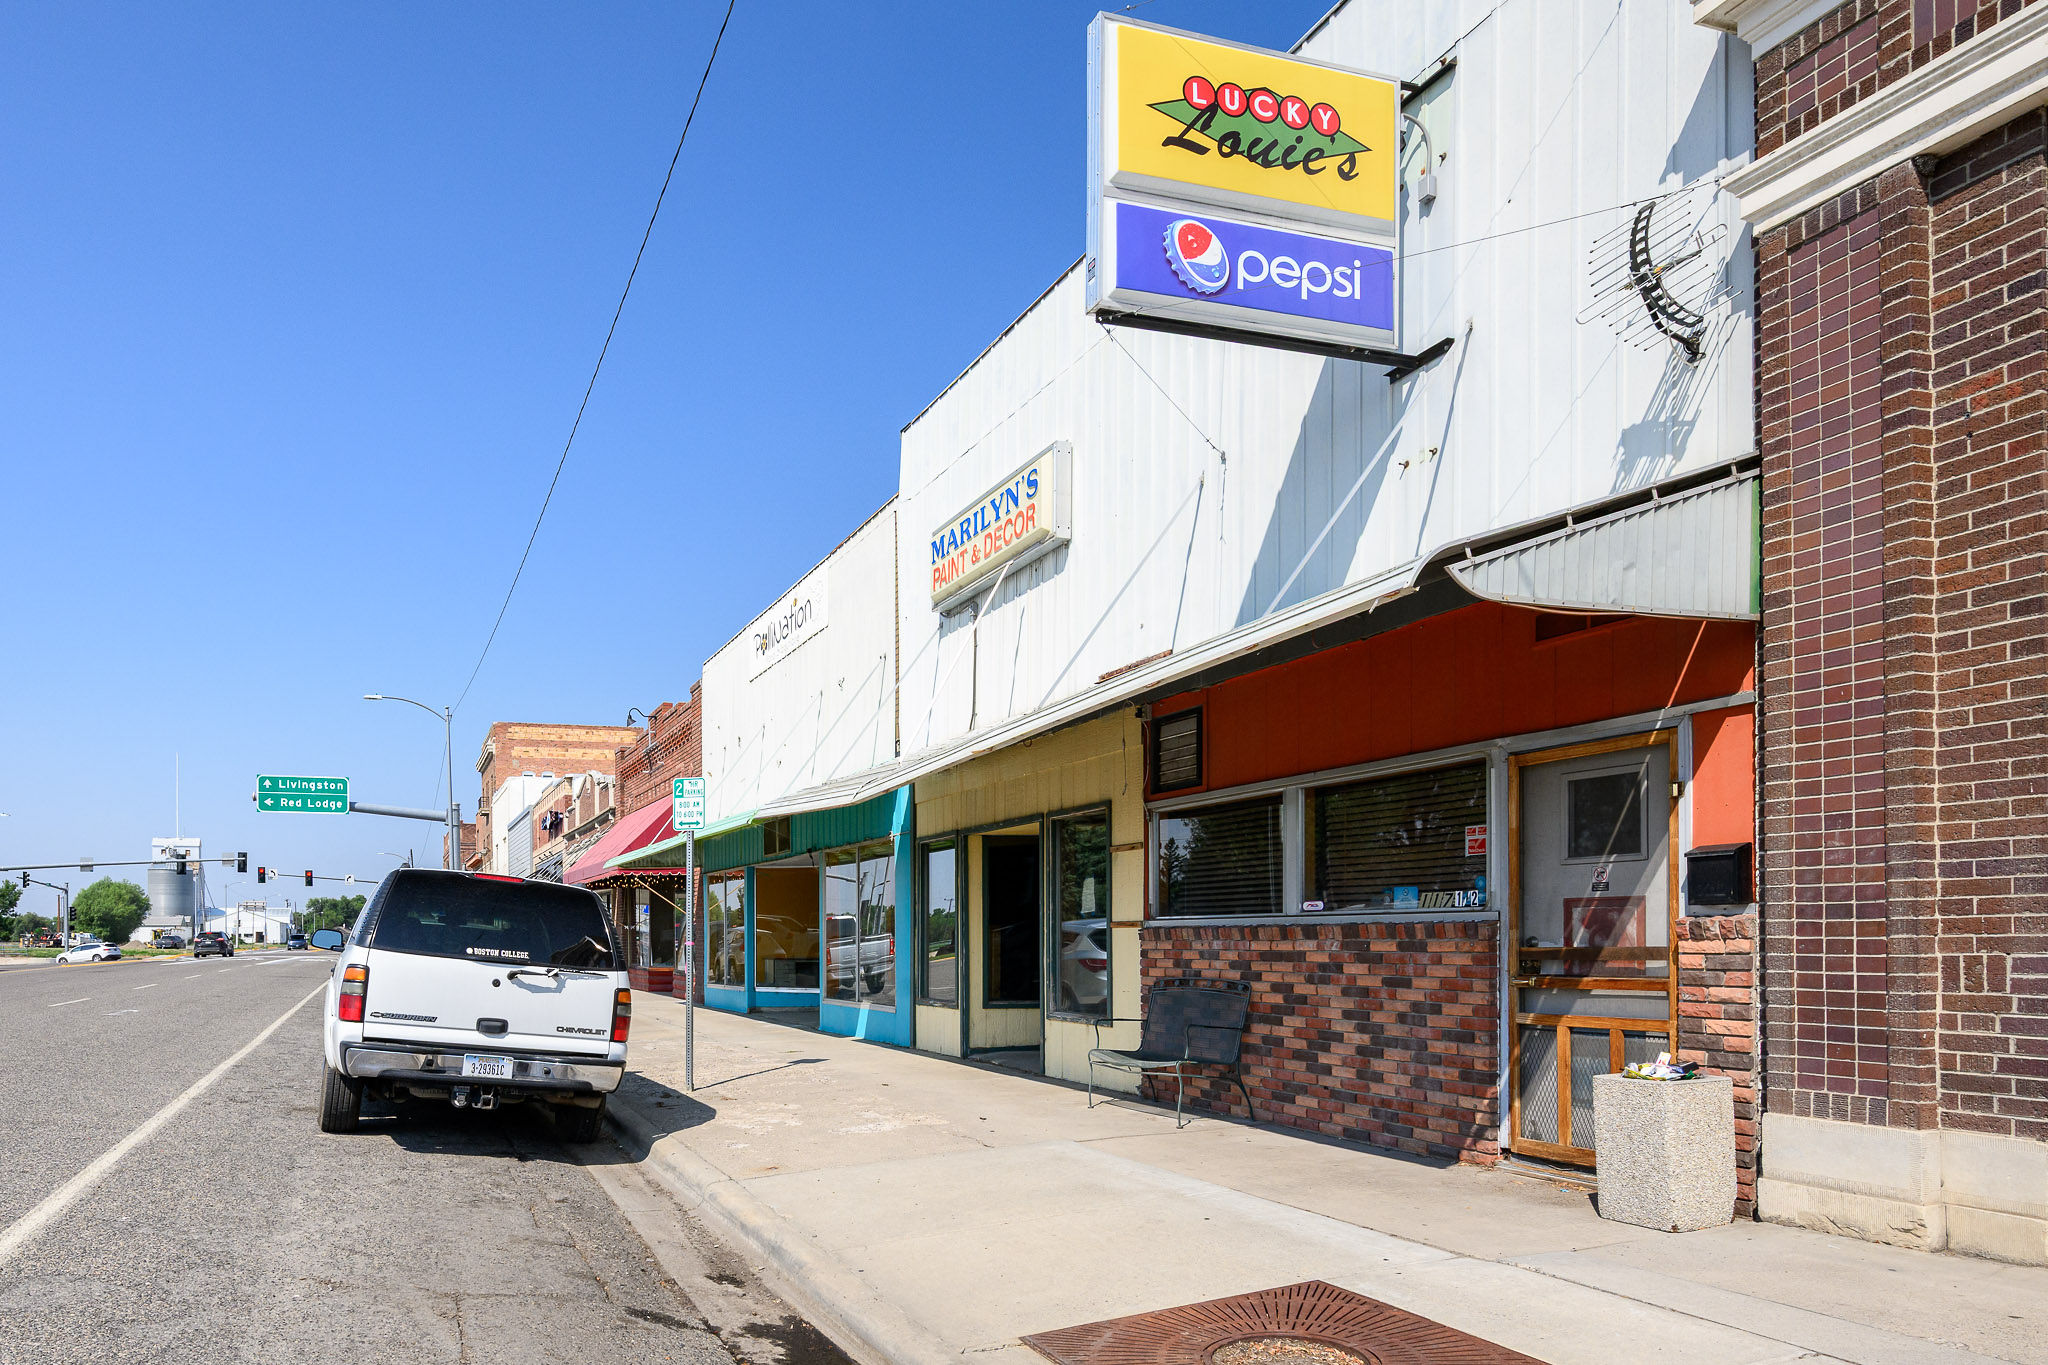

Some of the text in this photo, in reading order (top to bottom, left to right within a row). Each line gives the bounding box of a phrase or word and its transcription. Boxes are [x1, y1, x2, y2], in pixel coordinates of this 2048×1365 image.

[1192, 81, 1333, 130] LUCKY
[1161, 102, 1360, 181] Louie's
[1236, 250, 1362, 300] pepsi
[931, 468, 1039, 565] MARILYN'S
[932, 502, 1036, 592] PAINT & DECOR
[278, 779, 344, 791] Livingston
[675, 782, 683, 796] 2
[684, 788, 704, 796] PARKING
[280, 797, 343, 810] Red Lodge
[474, 947, 530, 959] BOSTON COLLEGE
[556, 1026, 607, 1036] CHEVROLET
